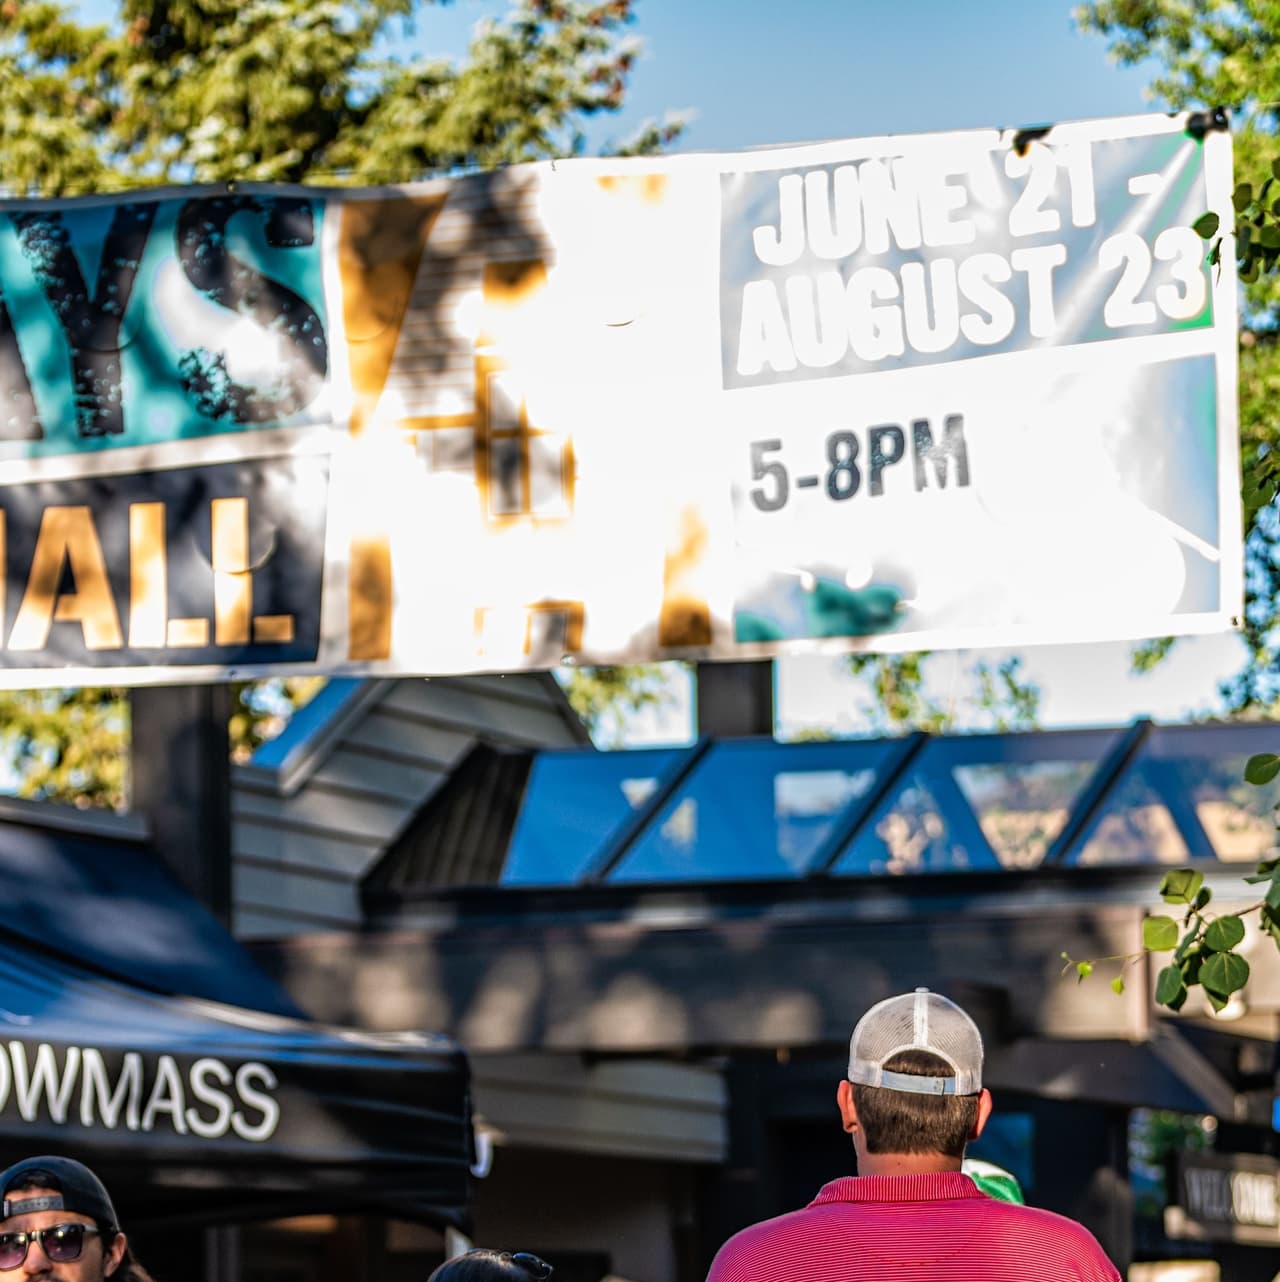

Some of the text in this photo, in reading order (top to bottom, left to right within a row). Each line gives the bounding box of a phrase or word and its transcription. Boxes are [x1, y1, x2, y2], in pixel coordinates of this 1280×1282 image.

[752, 156, 977, 267] JUNE
[1005, 142, 1097, 237] 21
[736, 226, 1207, 376] AUGUST 23
[748, 413, 971, 513] 5-8PM
